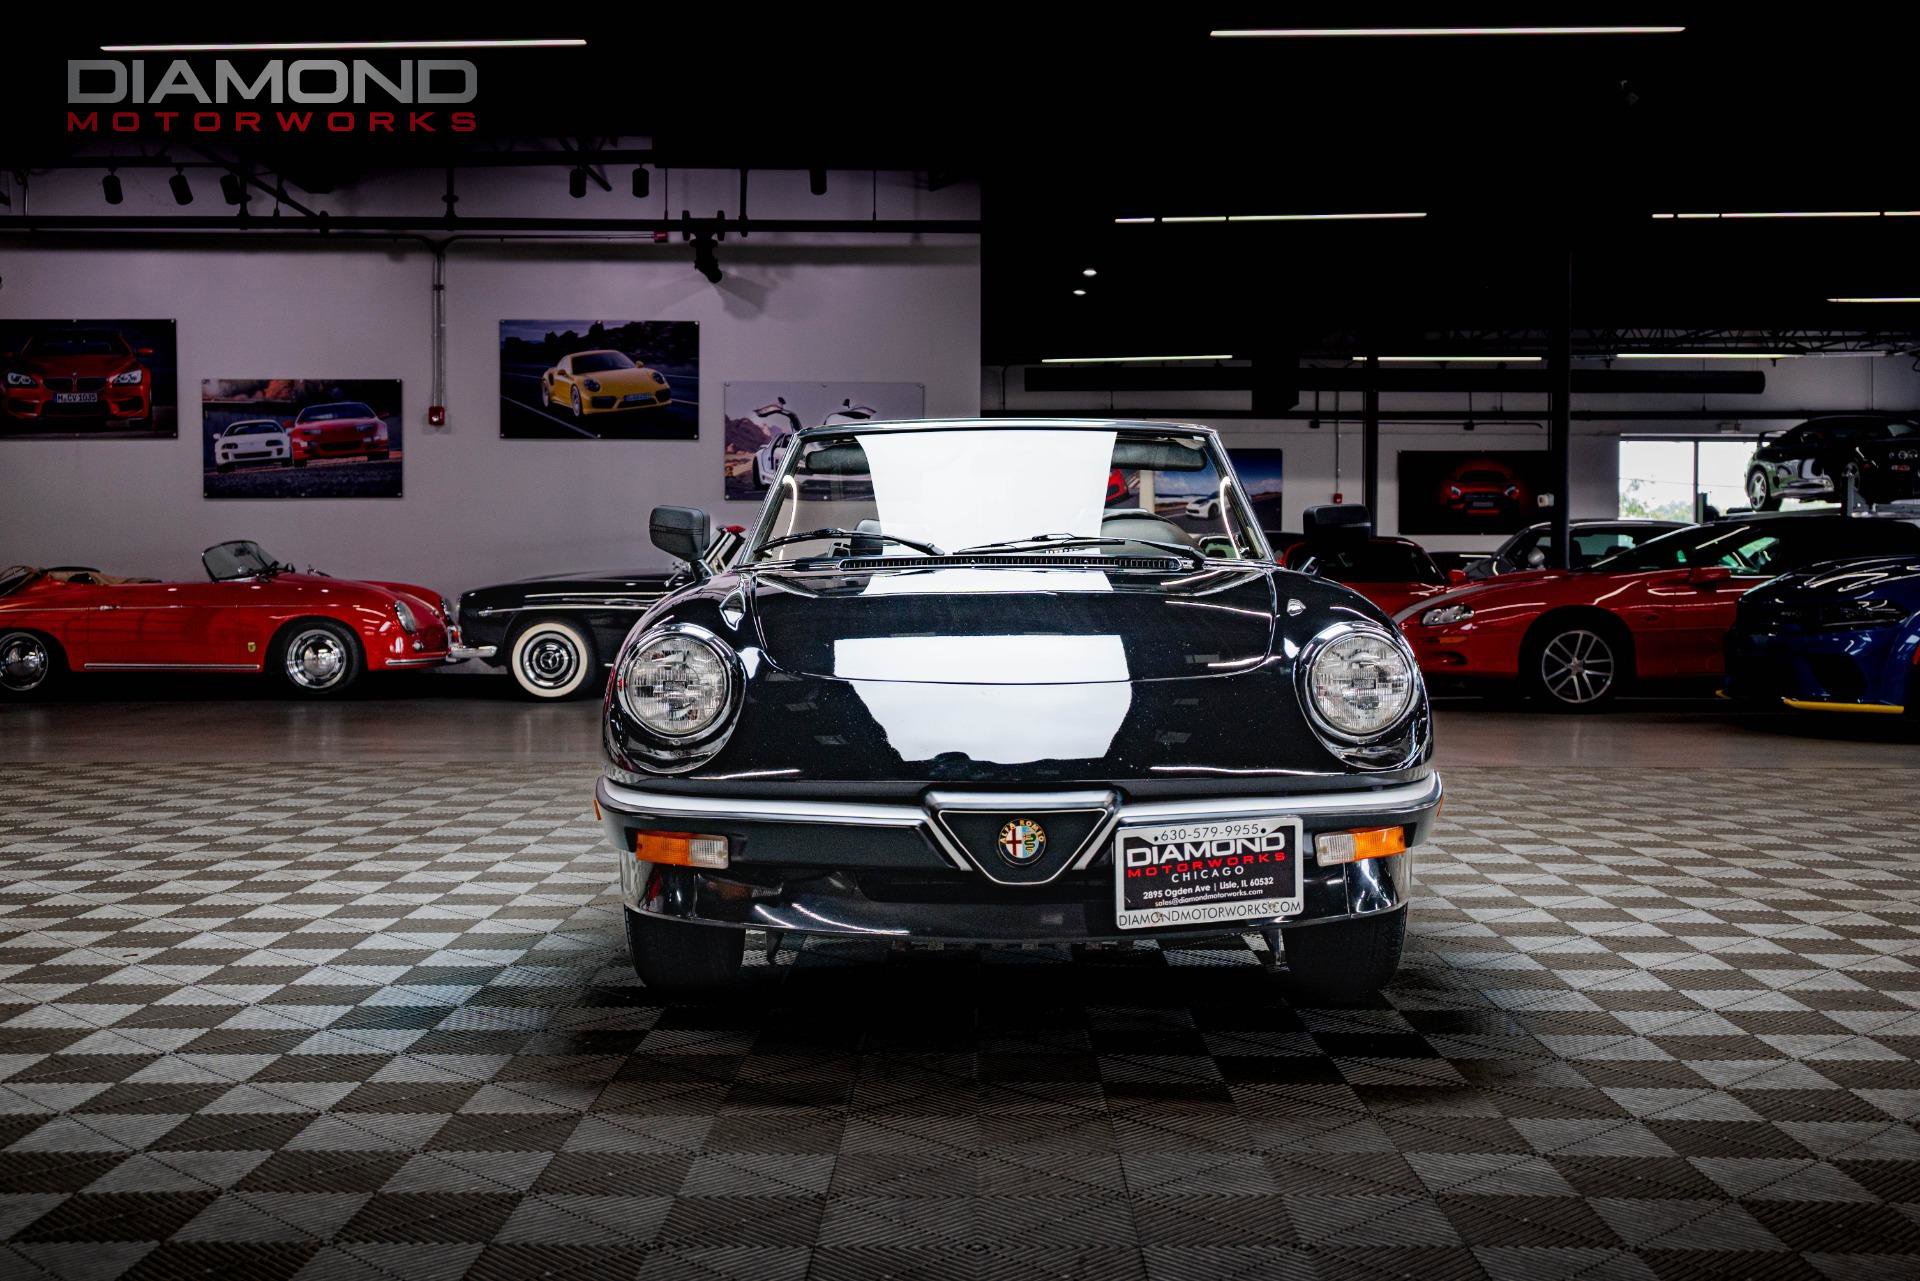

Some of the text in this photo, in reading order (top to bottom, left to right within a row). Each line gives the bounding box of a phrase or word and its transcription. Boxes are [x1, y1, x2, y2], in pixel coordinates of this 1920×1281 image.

[1160, 823, 1259, 841] 630-579-9955
[1126, 832, 1286, 868] DIAMOND
[1127, 851, 1286, 878] MOTORWORKS
[1171, 865, 1244, 883] CHICAGO
[1142, 889, 1163, 900] 2895
[1164, 885, 1193, 898] Ogden
[1194, 883, 1211, 895] Ave
[1241, 879, 1249, 888] IL
[1249, 876, 1274, 887] 60532
[1154, 888, 1264, 908] sales@diamondmotorworks.com
[1119, 901, 1301, 927] DIAMONDMOTORWORKS.COM
